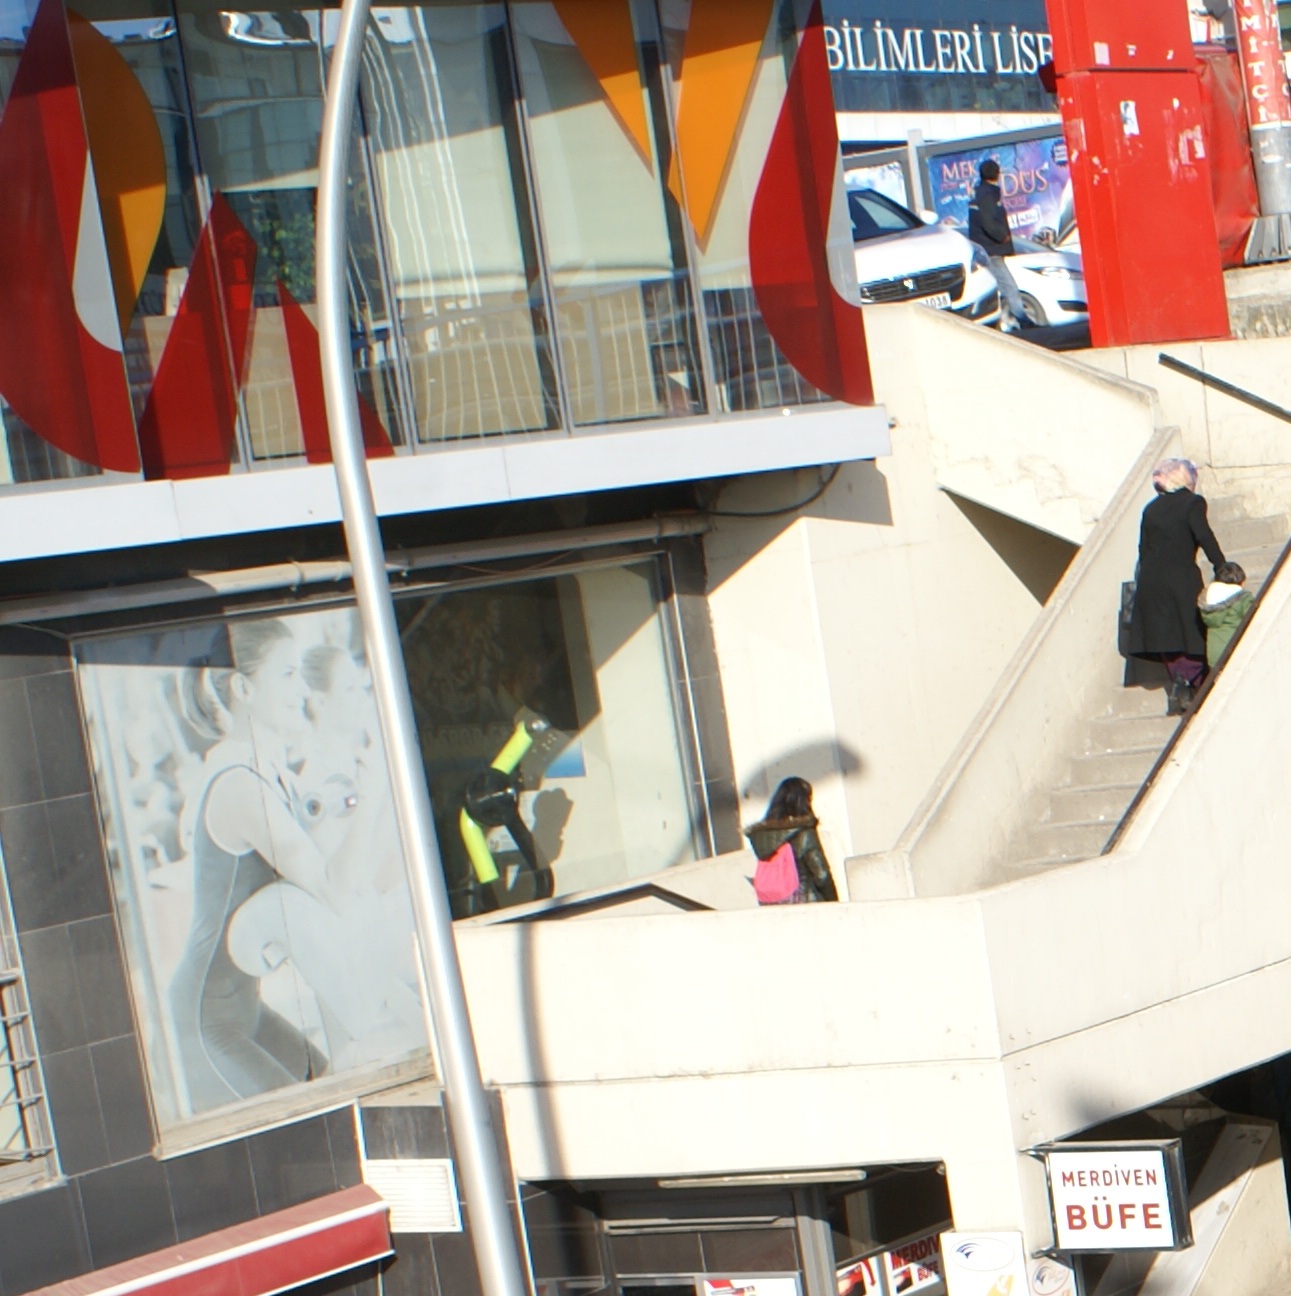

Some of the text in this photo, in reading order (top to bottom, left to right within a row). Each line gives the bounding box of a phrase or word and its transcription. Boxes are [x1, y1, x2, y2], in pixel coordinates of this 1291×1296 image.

[823, 19, 987, 73] BİLİMLERİ
[1062, 1164, 1157, 1187] MERDİVEN
[1066, 1196, 1162, 1230] BÜFE
